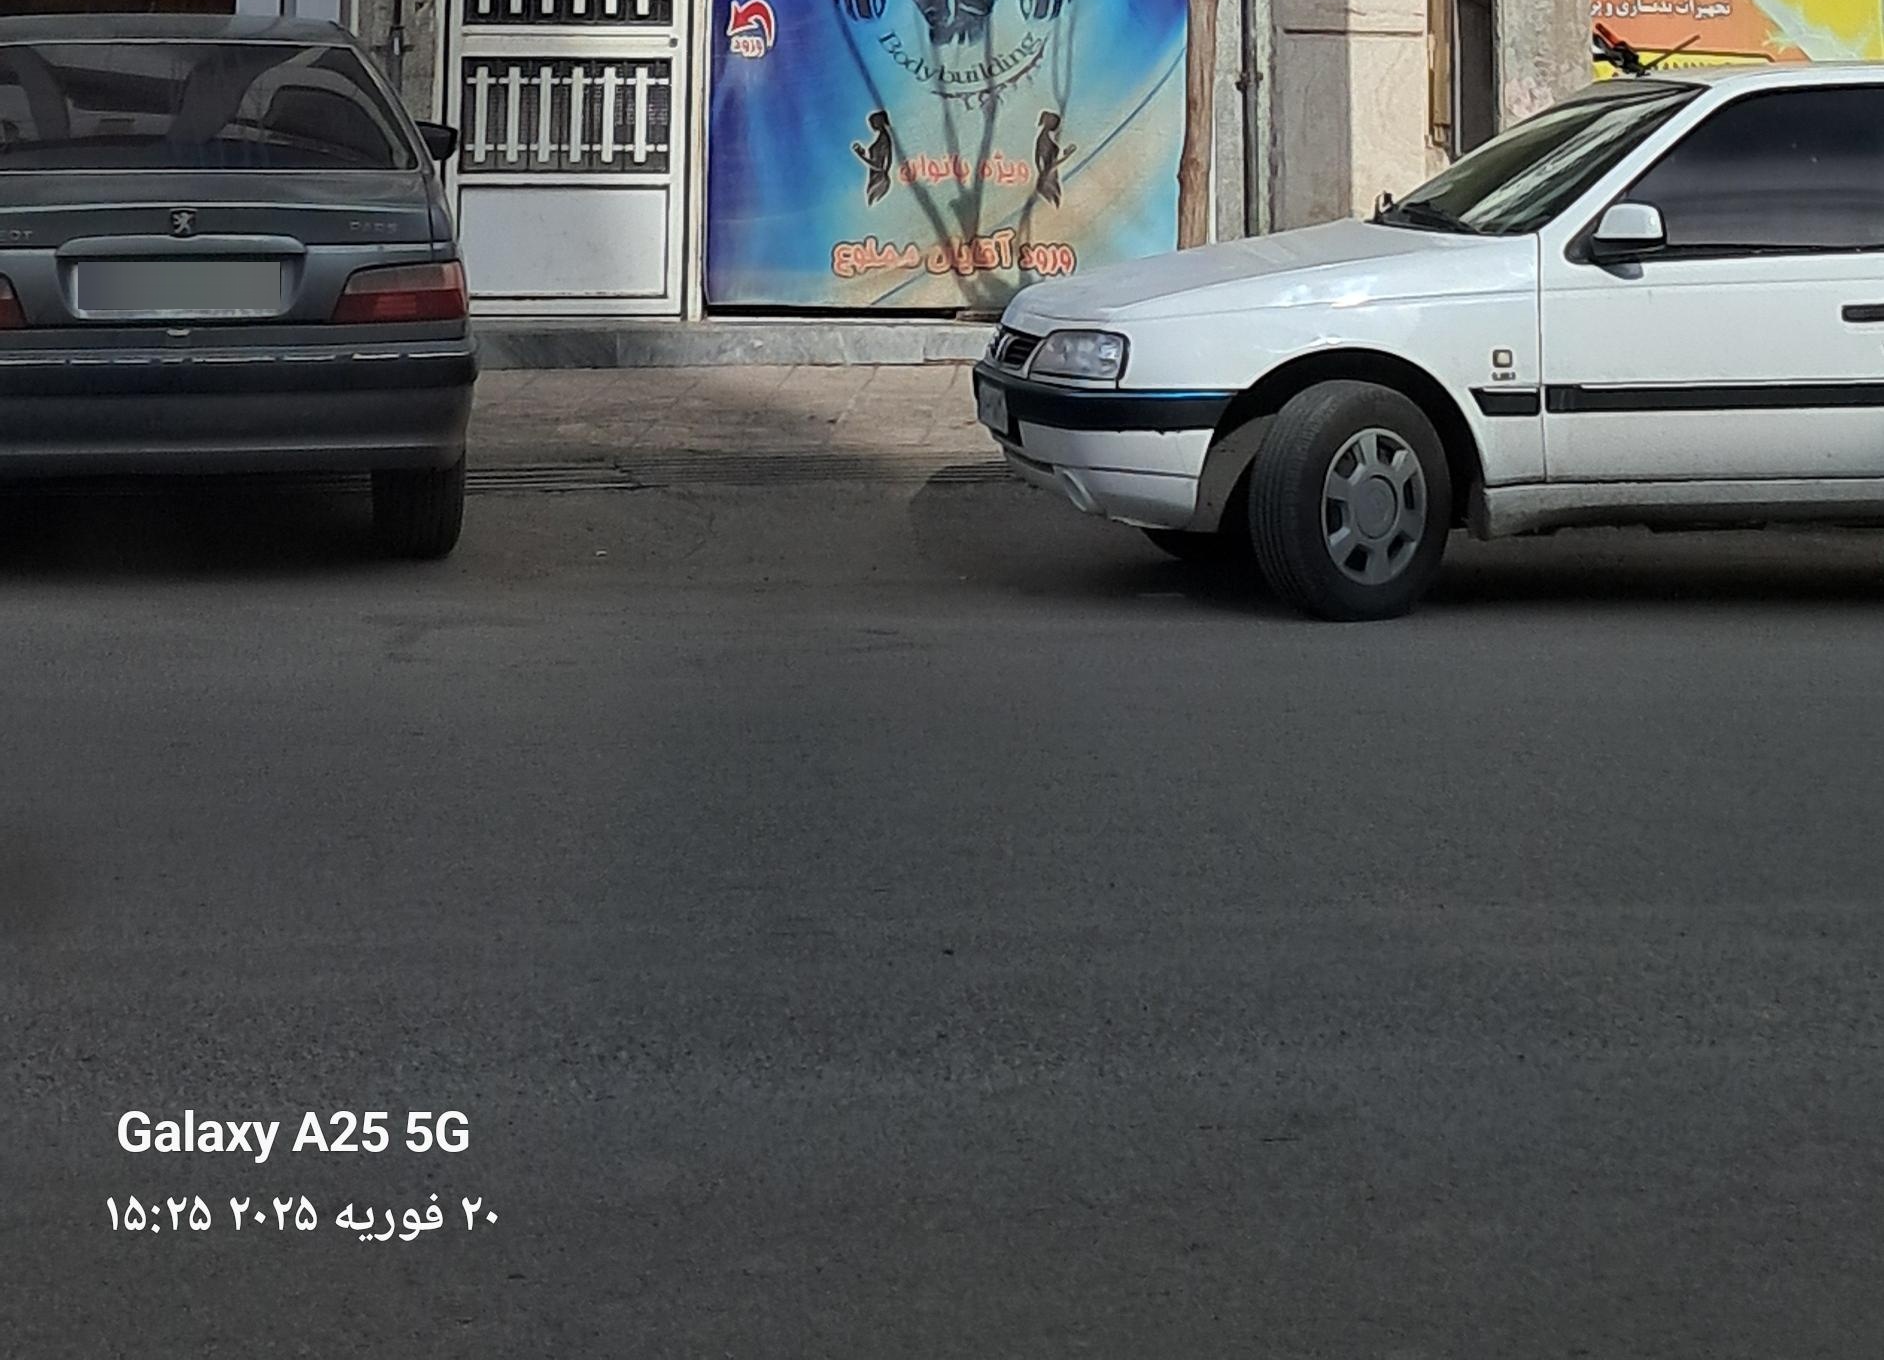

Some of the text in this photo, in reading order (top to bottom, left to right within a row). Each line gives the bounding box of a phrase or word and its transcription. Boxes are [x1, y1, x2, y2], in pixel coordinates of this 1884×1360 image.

[731, 36, 765, 58] ورود
[878, 31, 1046, 86] Bodybuilding
[899, 150, 1031, 184] ویژه بانوان
[926, 227, 1016, 276] آقایان
[1018, 242, 1077, 276] ورود
